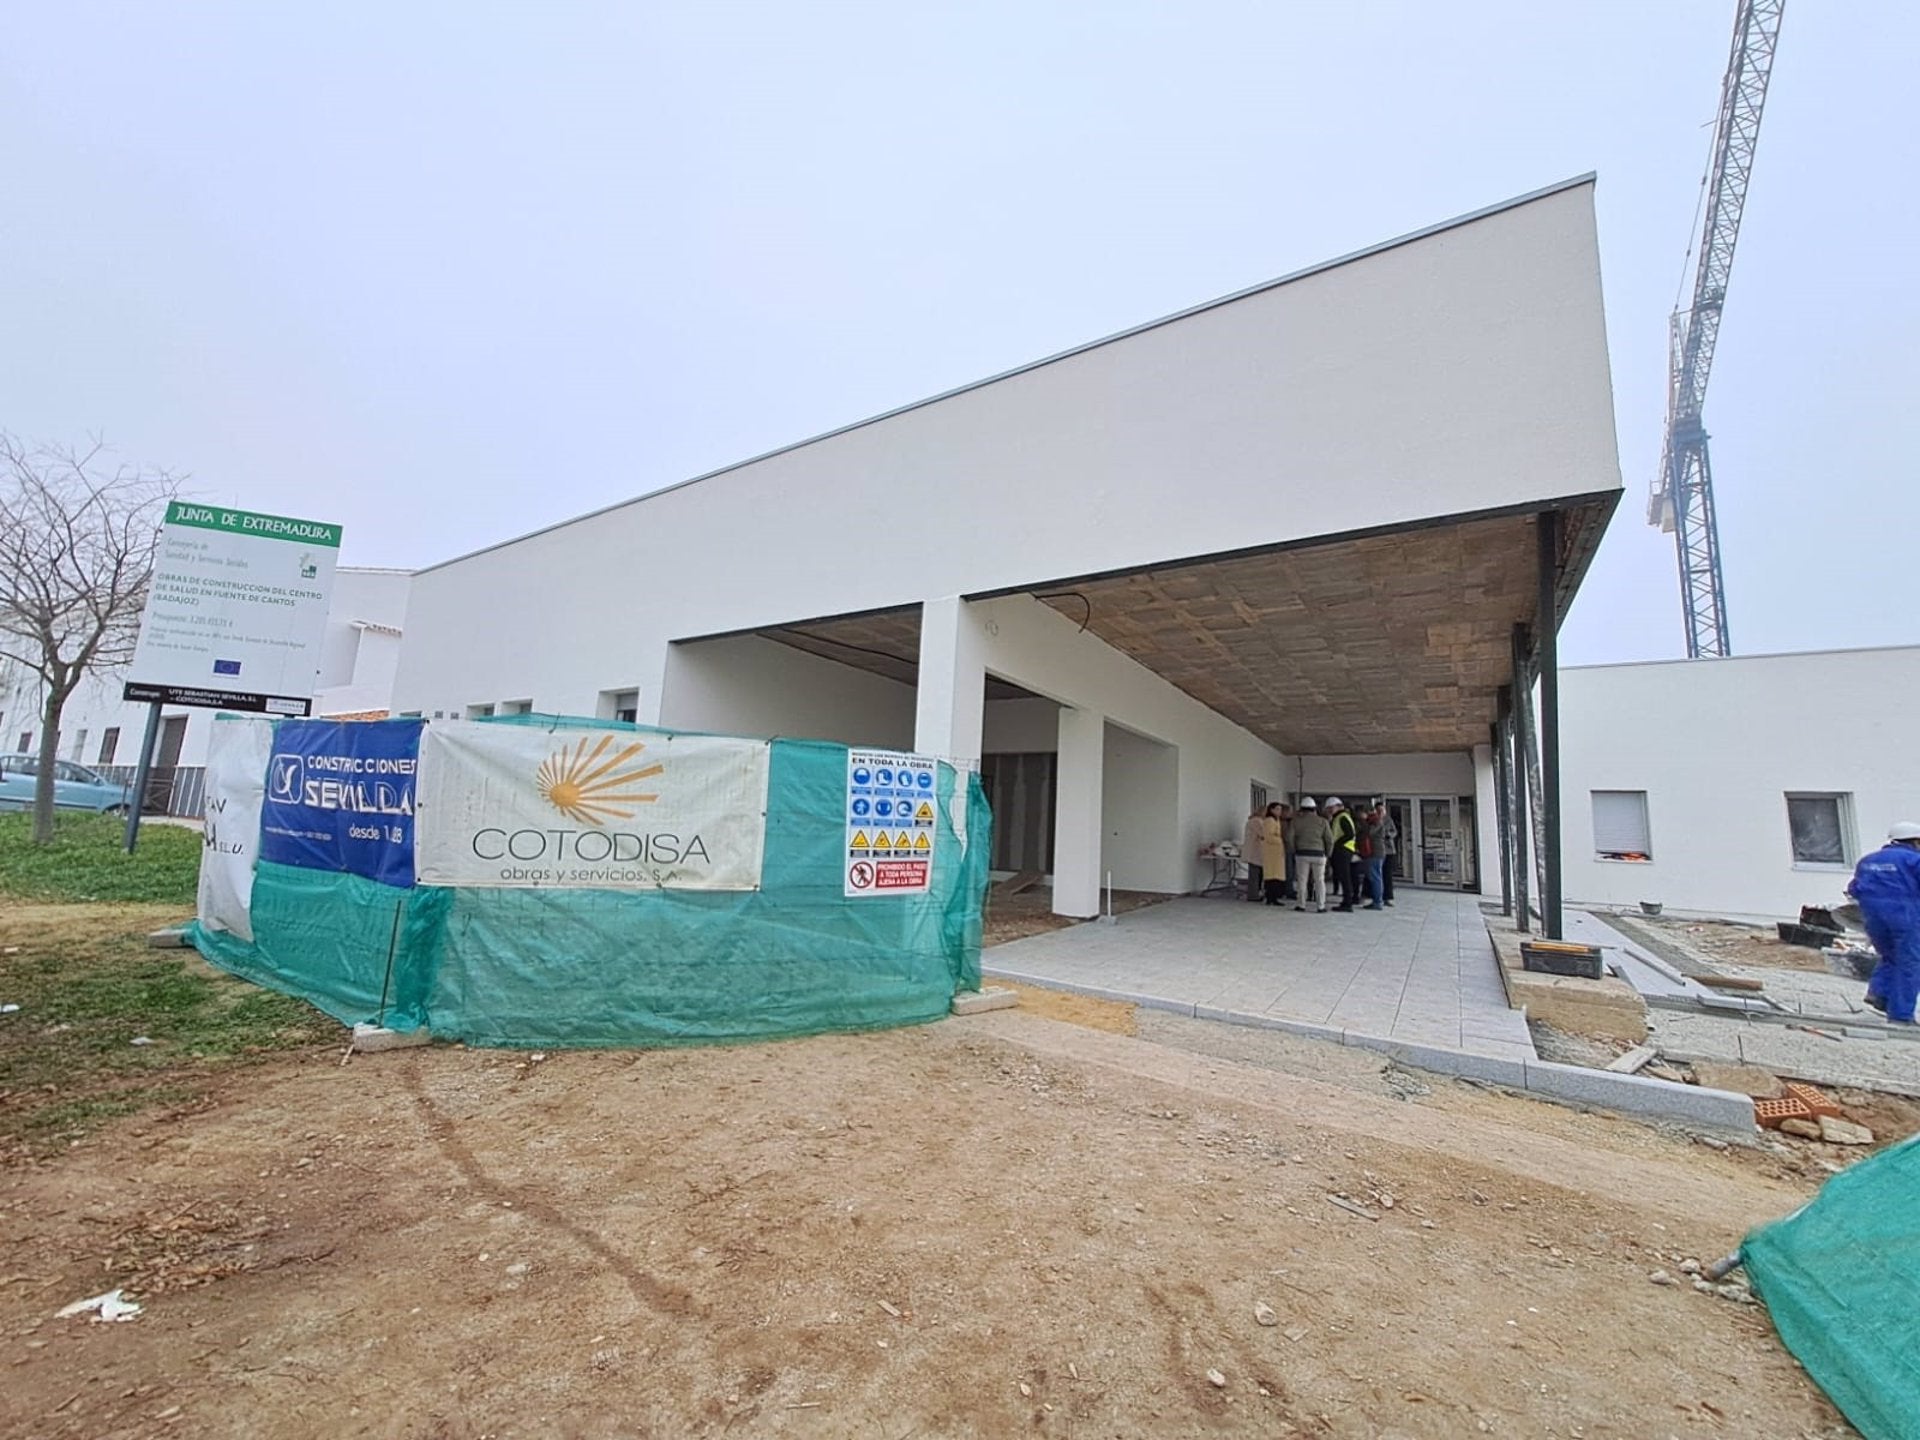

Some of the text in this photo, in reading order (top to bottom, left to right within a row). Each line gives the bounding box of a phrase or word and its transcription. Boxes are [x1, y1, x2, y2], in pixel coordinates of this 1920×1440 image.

[176, 506, 332, 540] JUNTA DE EXTREMADURA
[155, 583, 295, 607] DE SALUD EN FUENTE DE CANTOS
[158, 572, 187, 583] OBRAS
[188, 576, 200, 585] DE
[272, 587, 287, 595] DEL
[289, 589, 322, 600] CENTRO
[869, 758, 894, 766] TODA
[910, 761, 934, 770] OBRA
[349, 823, 380, 841] desde
[472, 828, 711, 865] COTODISA
[500, 866, 550, 881] obras
[556, 868, 566, 883] y
